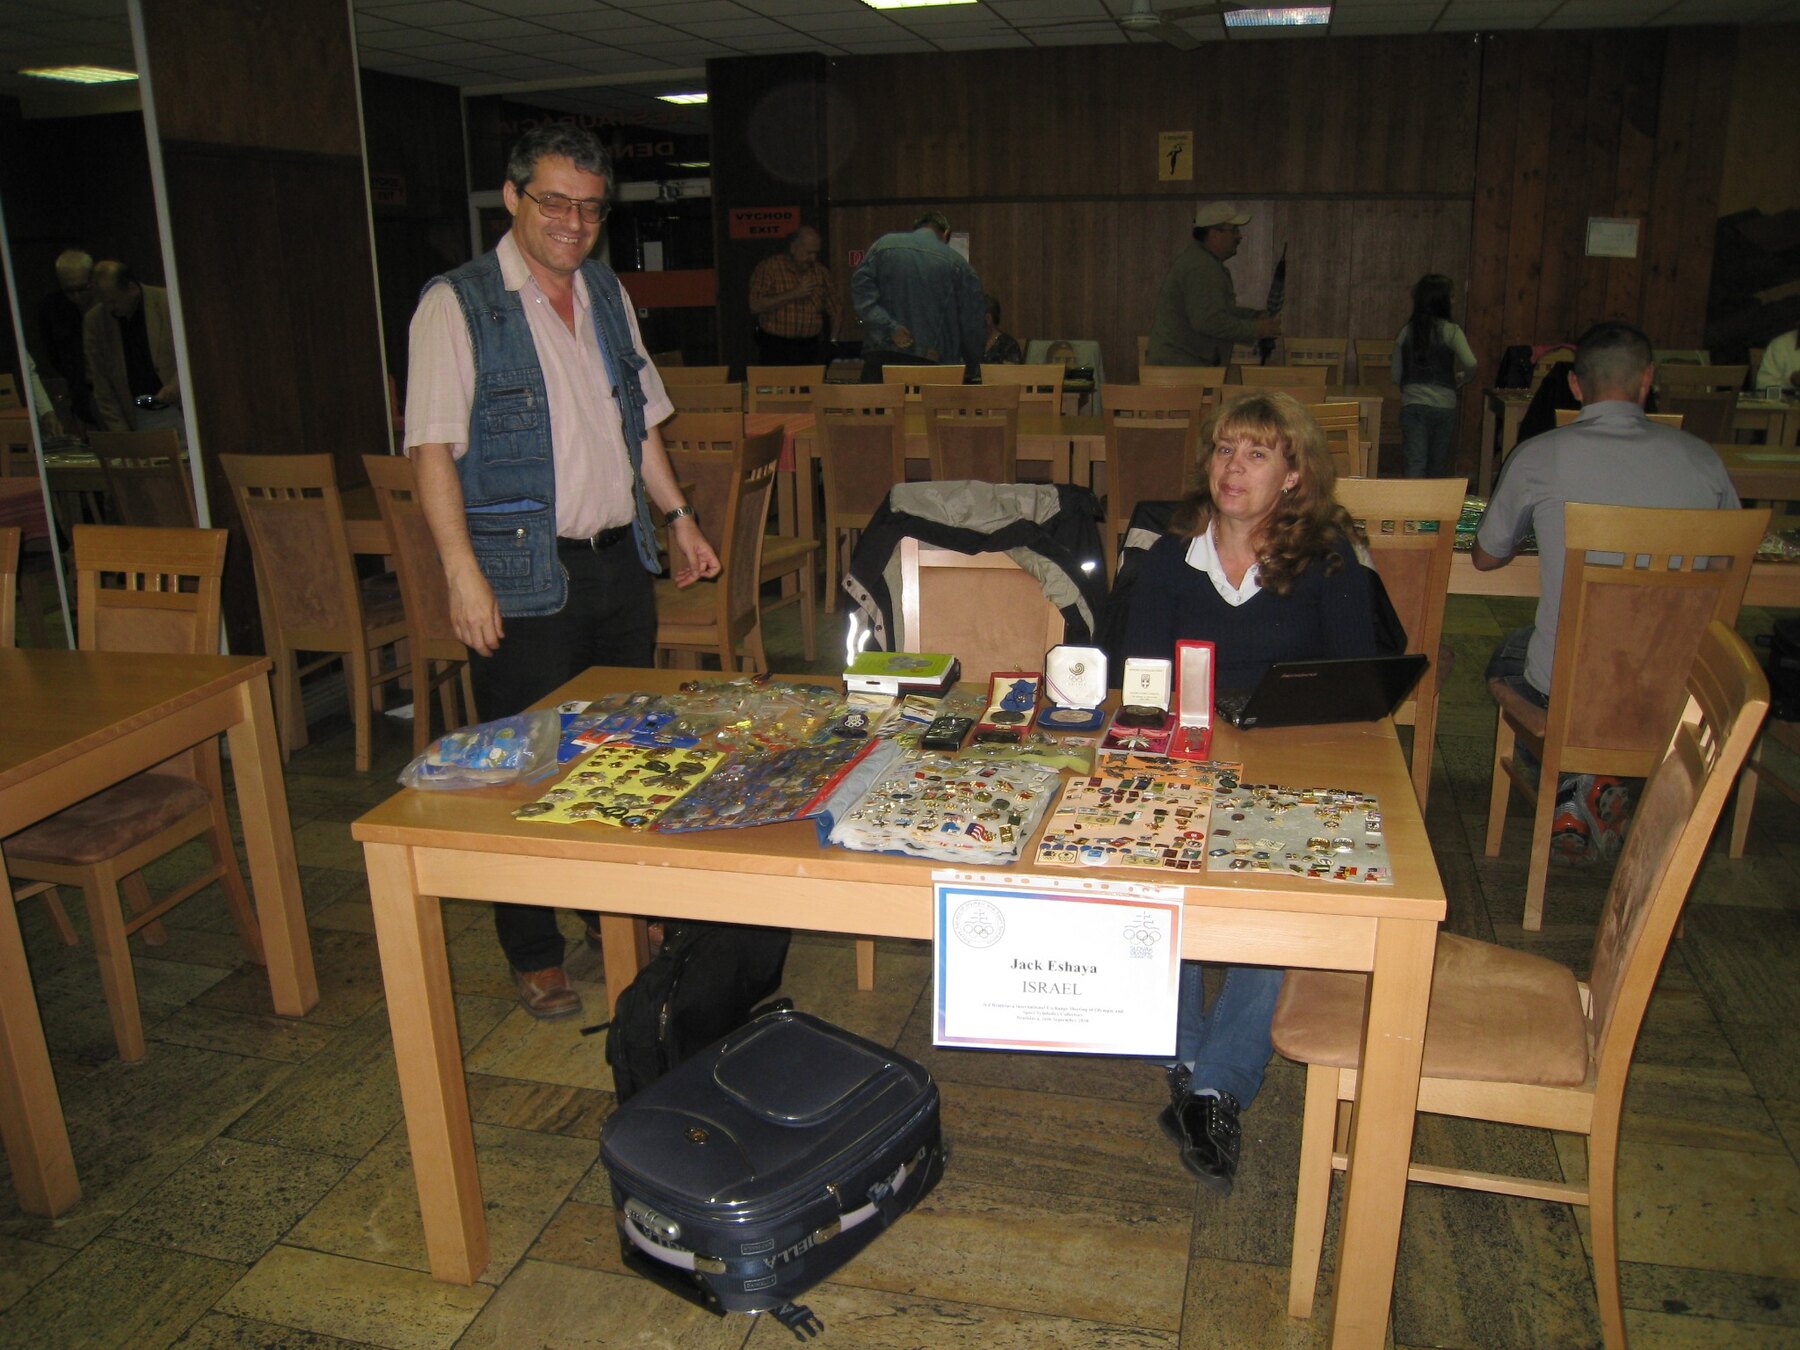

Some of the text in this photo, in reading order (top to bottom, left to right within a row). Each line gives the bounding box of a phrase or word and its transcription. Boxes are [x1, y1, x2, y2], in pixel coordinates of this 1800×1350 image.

[749, 225, 780, 234] EXIT
[1010, 957, 1098, 976] Jack Eshaya
[1022, 980, 1083, 996] ISRAEL
